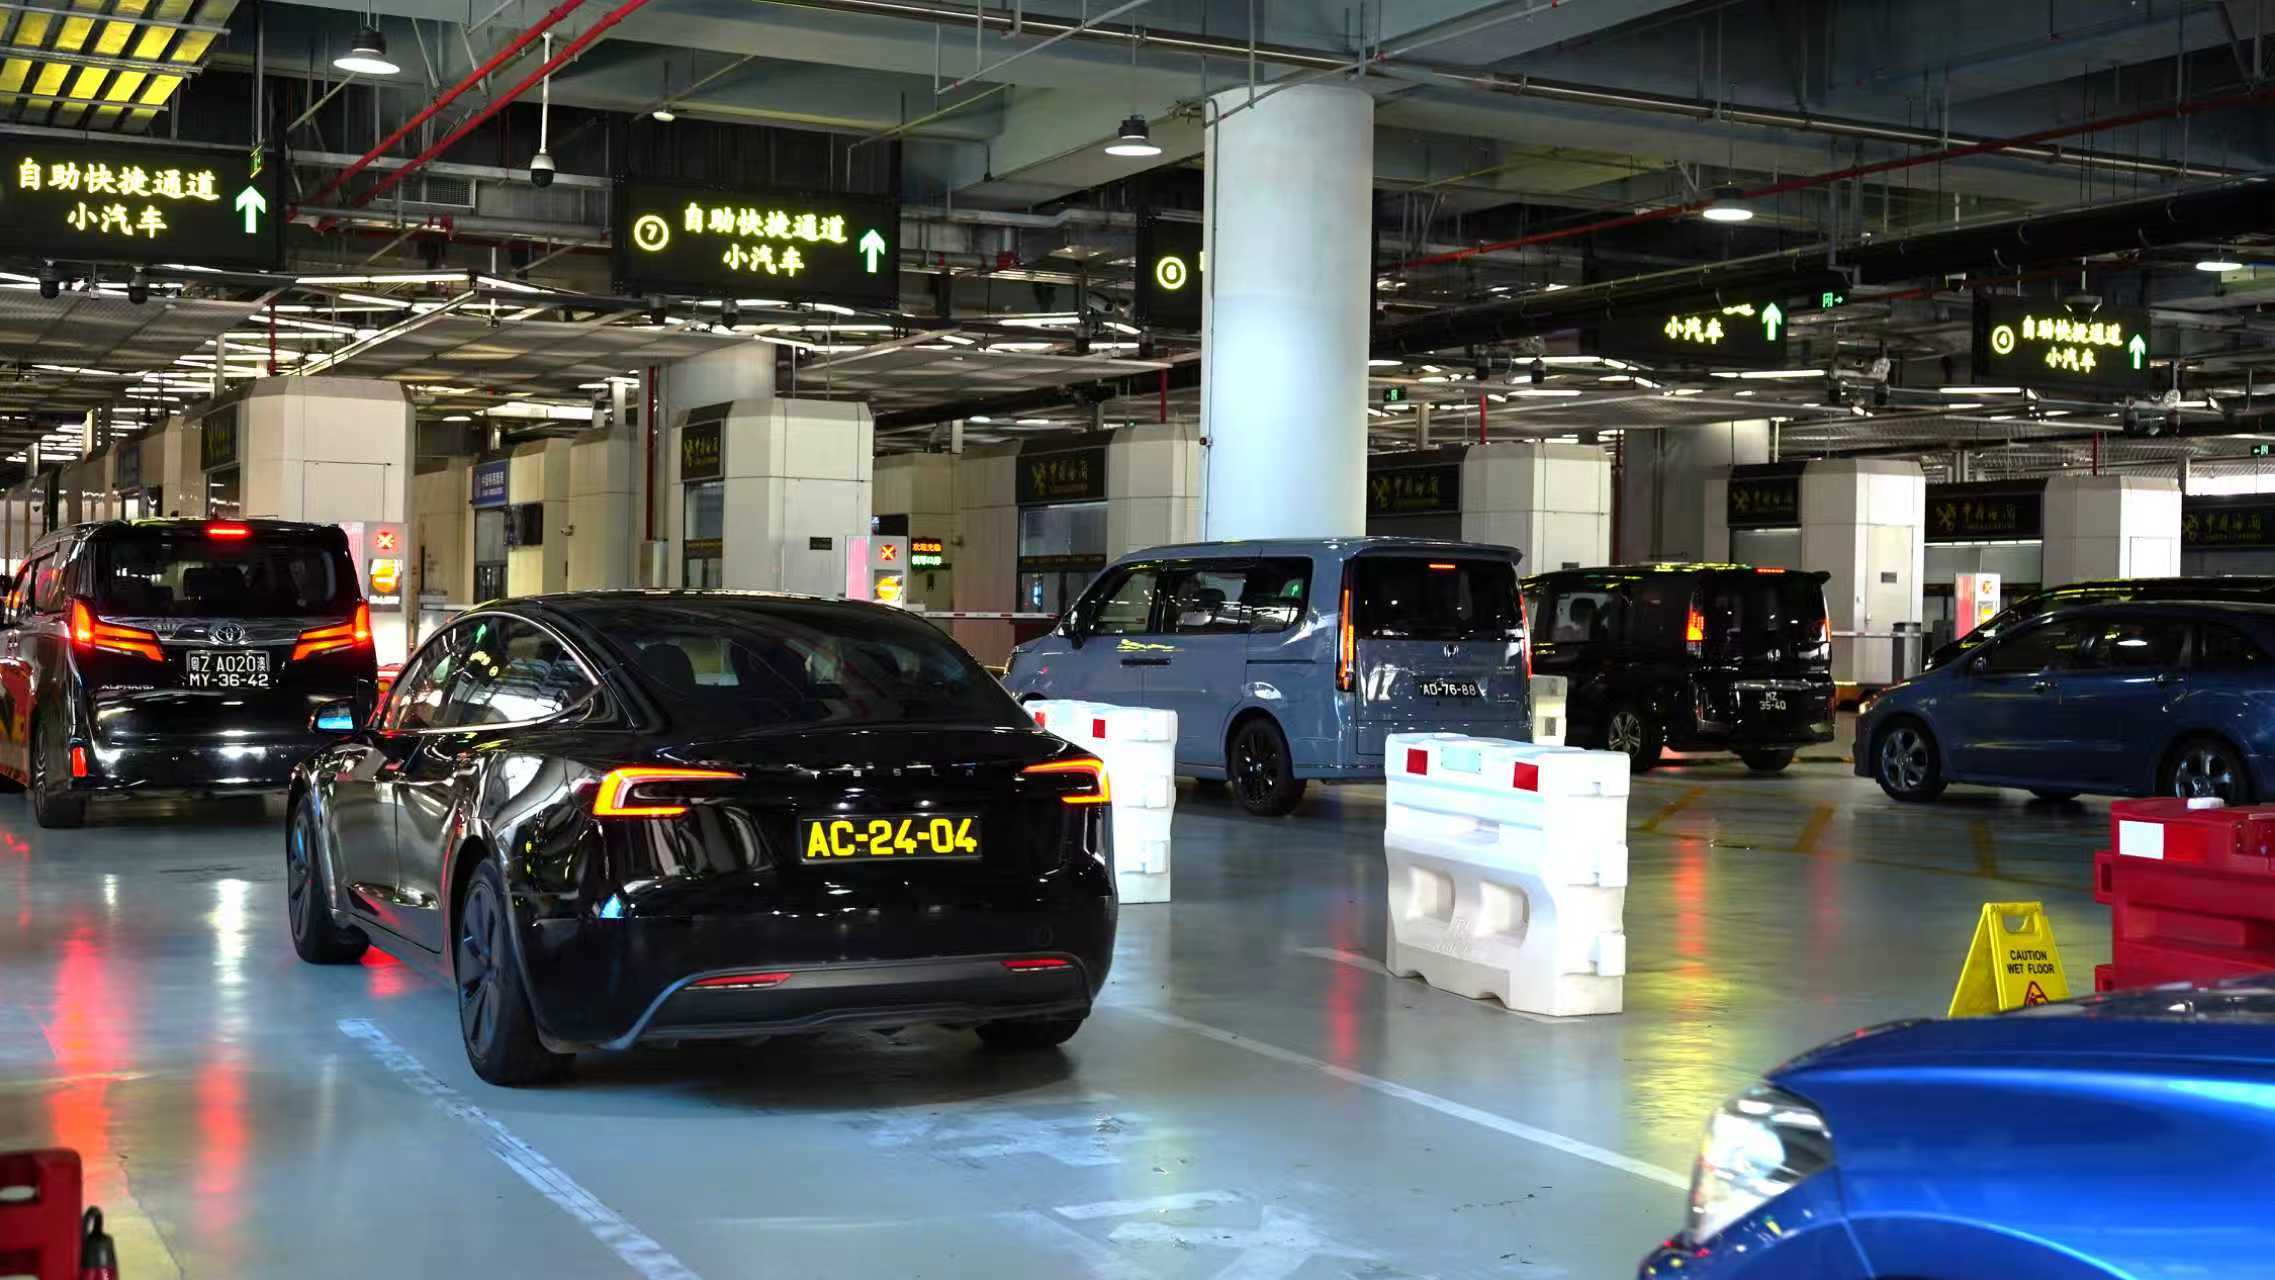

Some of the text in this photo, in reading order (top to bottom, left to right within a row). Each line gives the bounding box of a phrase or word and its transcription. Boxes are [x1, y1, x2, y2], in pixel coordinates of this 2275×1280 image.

[19, 157, 220, 200] 自助快捷通道
[67, 202, 168, 238] 小汽车
[685, 203, 848, 243] 自助快捷通道
[723, 243, 805, 277] 小汽车
[1664, 315, 1725, 345] 小汽车
[2045, 346, 2097, 373] 小汽车
[189, 673, 269, 687] MY-36-42
[807, 818, 977, 857] AC-24-04
[2007, 963, 2055, 974] WET FLOOR
[2010, 950, 2048, 961] CAUTION
